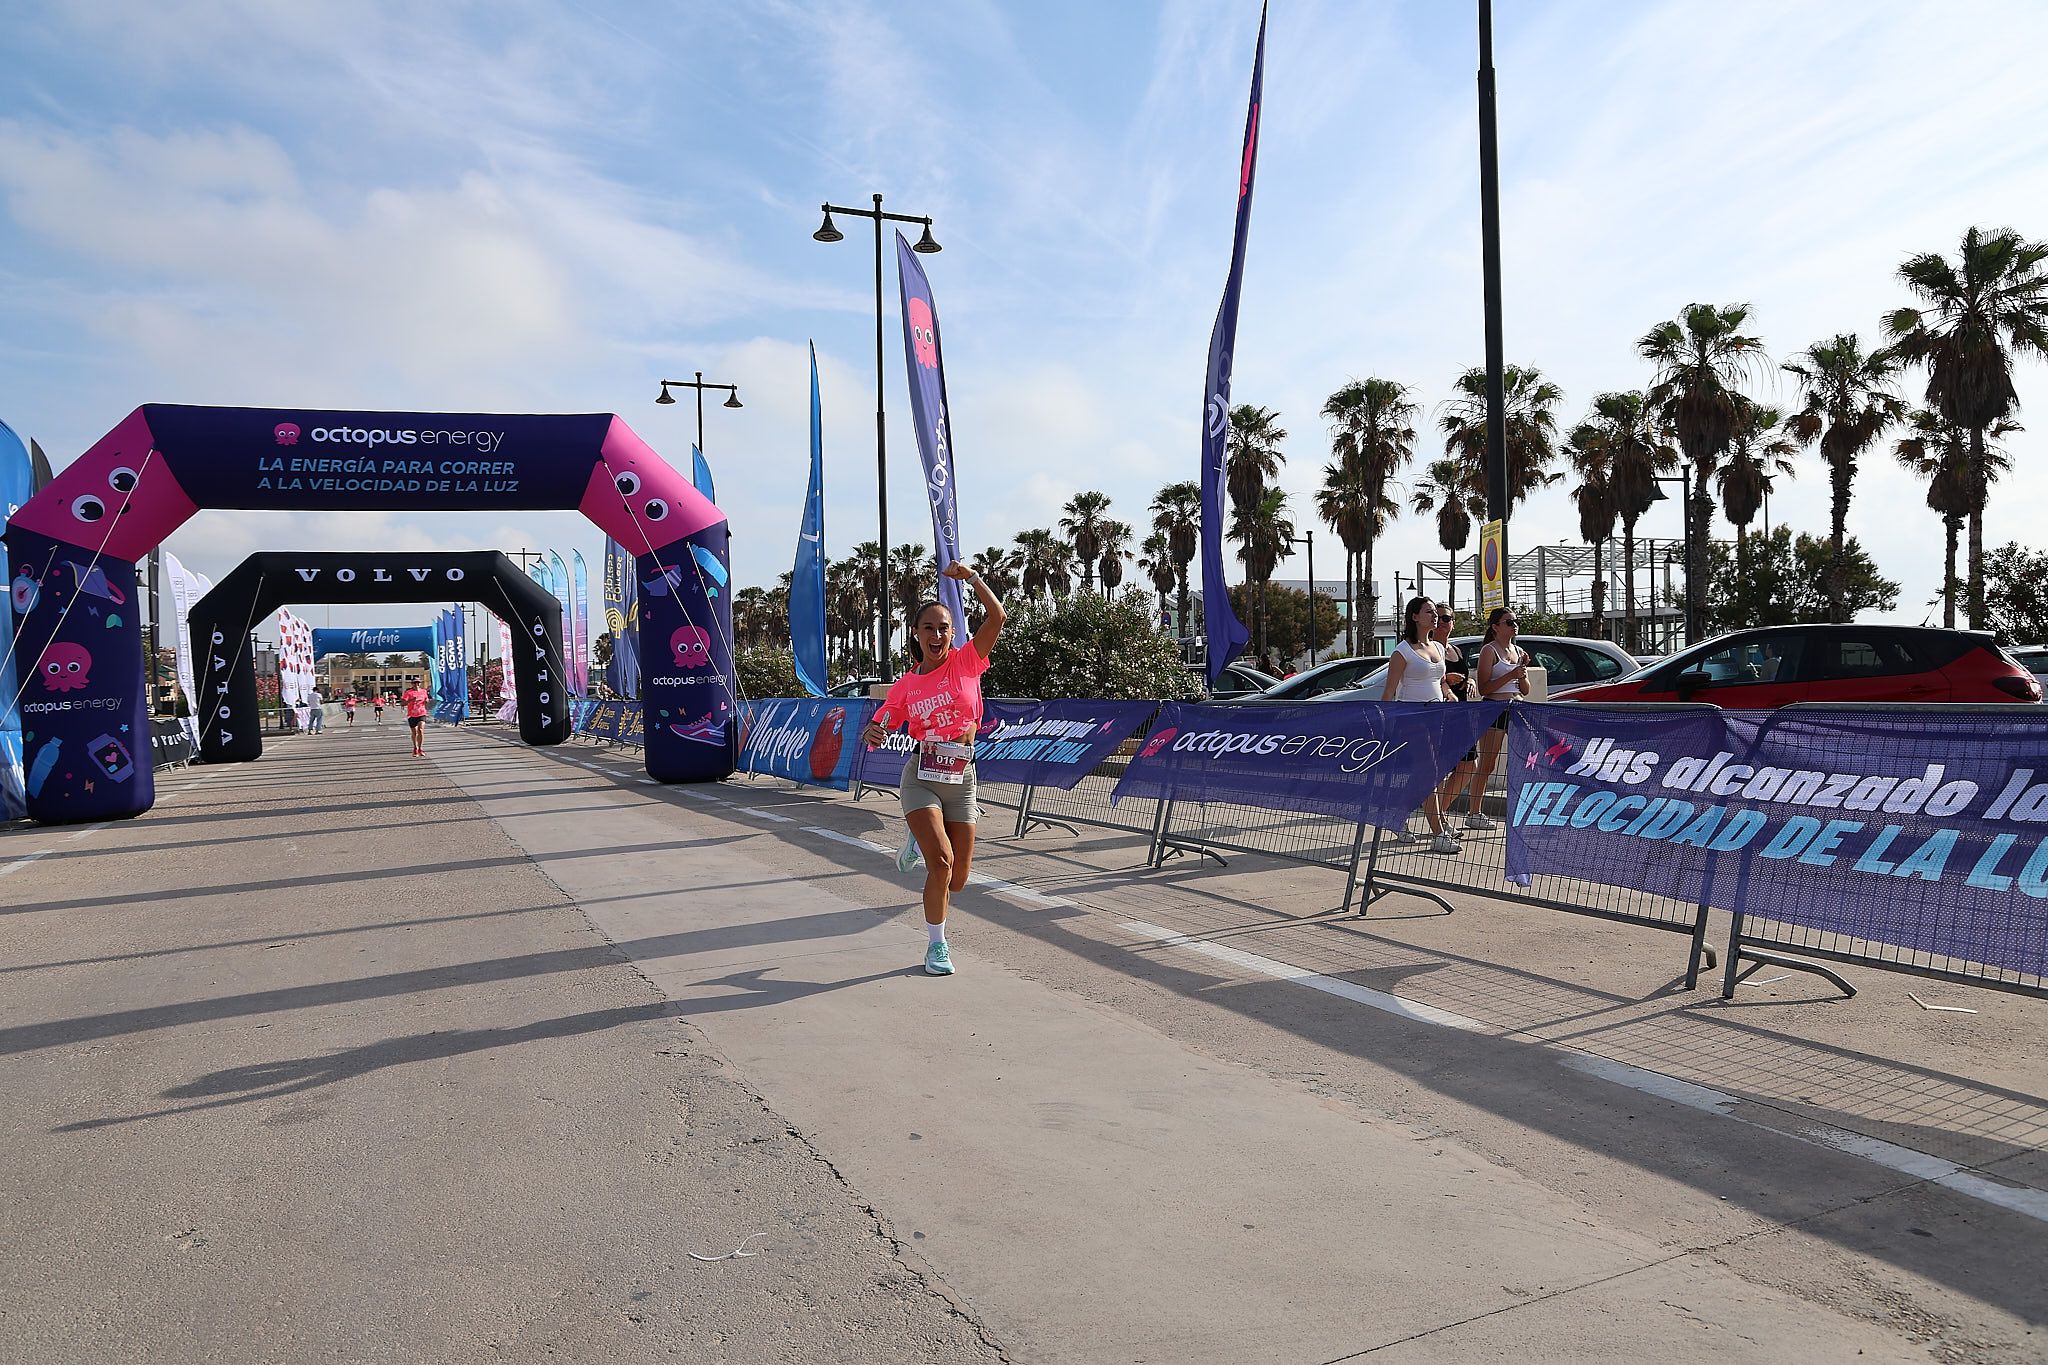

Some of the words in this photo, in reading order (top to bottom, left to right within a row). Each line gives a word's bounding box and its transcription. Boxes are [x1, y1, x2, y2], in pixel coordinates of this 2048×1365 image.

[310, 426, 417, 448] octopus
[420, 430, 505, 453] energy
[258, 457, 285, 472] LA
[290, 455, 377, 474] ENERGÍA
[382, 460, 434, 475] PARA
[439, 461, 515, 476] CORRER
[256, 477, 272, 490] A
[277, 477, 303, 491] LA
[309, 478, 421, 492] VELOCIDAD
[425, 480, 450, 492] DE
[454, 480, 479, 492] LA
[483, 481, 520, 493] LUZ
[294, 567, 465, 582] VOLVO
[351, 629, 401, 650] Marlene
[212, 631, 233, 746] VOLVO
[533, 624, 552, 729] VOLVO
[652, 676, 696, 687] octopus
[696, 673, 728, 686] energy
[23, 701, 72, 714] octopus
[72, 697, 123, 711] energy
[907, 690, 953, 718] CARRERA
[935, 709, 954, 728] DE
[1035, 717, 1098, 742] energía
[744, 701, 810, 772] Marlene
[936, 755, 956, 766] 016
[1038, 739, 1093, 764] FINAL
[1172, 729, 1288, 760] octopus
[1279, 734, 1408, 774] energy
[1565, 737, 1660, 785] Has
[1661, 751, 1979, 818] alcanzado
[1512, 781, 1769, 852] VELOCIDAD
[1758, 815, 1865, 867] DE
[1851, 824, 1961, 882] LA
